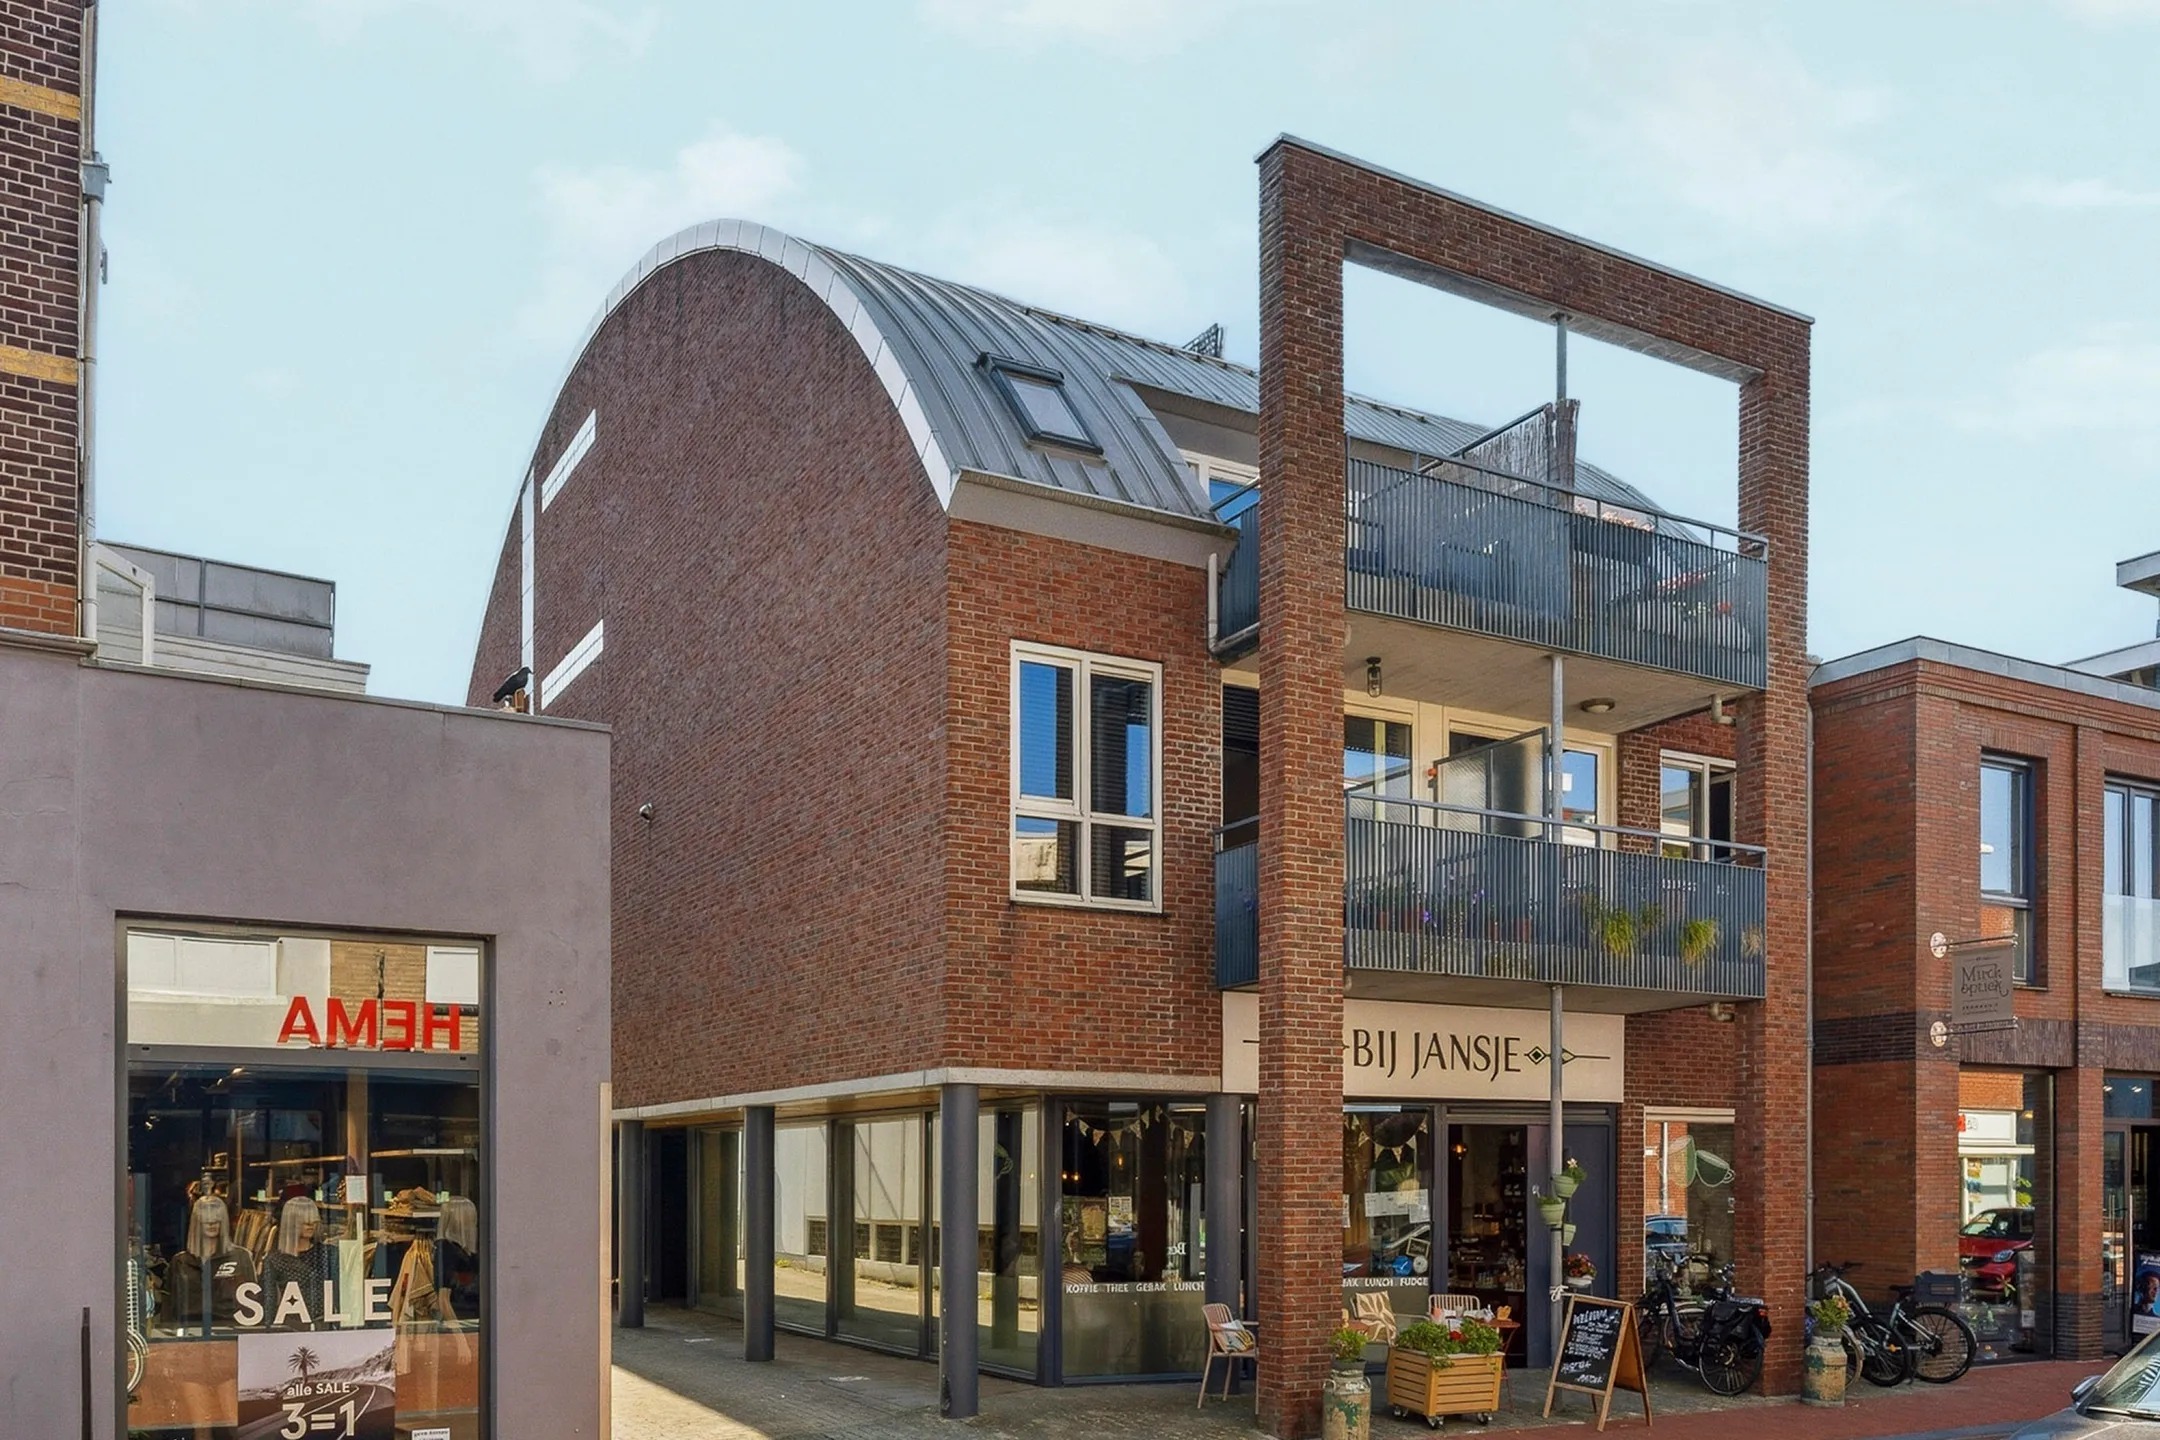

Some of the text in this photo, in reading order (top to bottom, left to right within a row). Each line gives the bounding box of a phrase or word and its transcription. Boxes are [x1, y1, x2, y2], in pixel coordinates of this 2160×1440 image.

[1352, 1028, 1522, 1082] BIJ JANSJE
[1066, 1281, 1205, 1294] KOFFIE THEE GEBAK LUNCH
[1364, 1277, 1393, 1287] LUNCH
[1400, 1276, 1429, 1286] FUDGE
[233, 1278, 392, 1326] SALE
[287, 1382, 350, 1396] alle SALE
